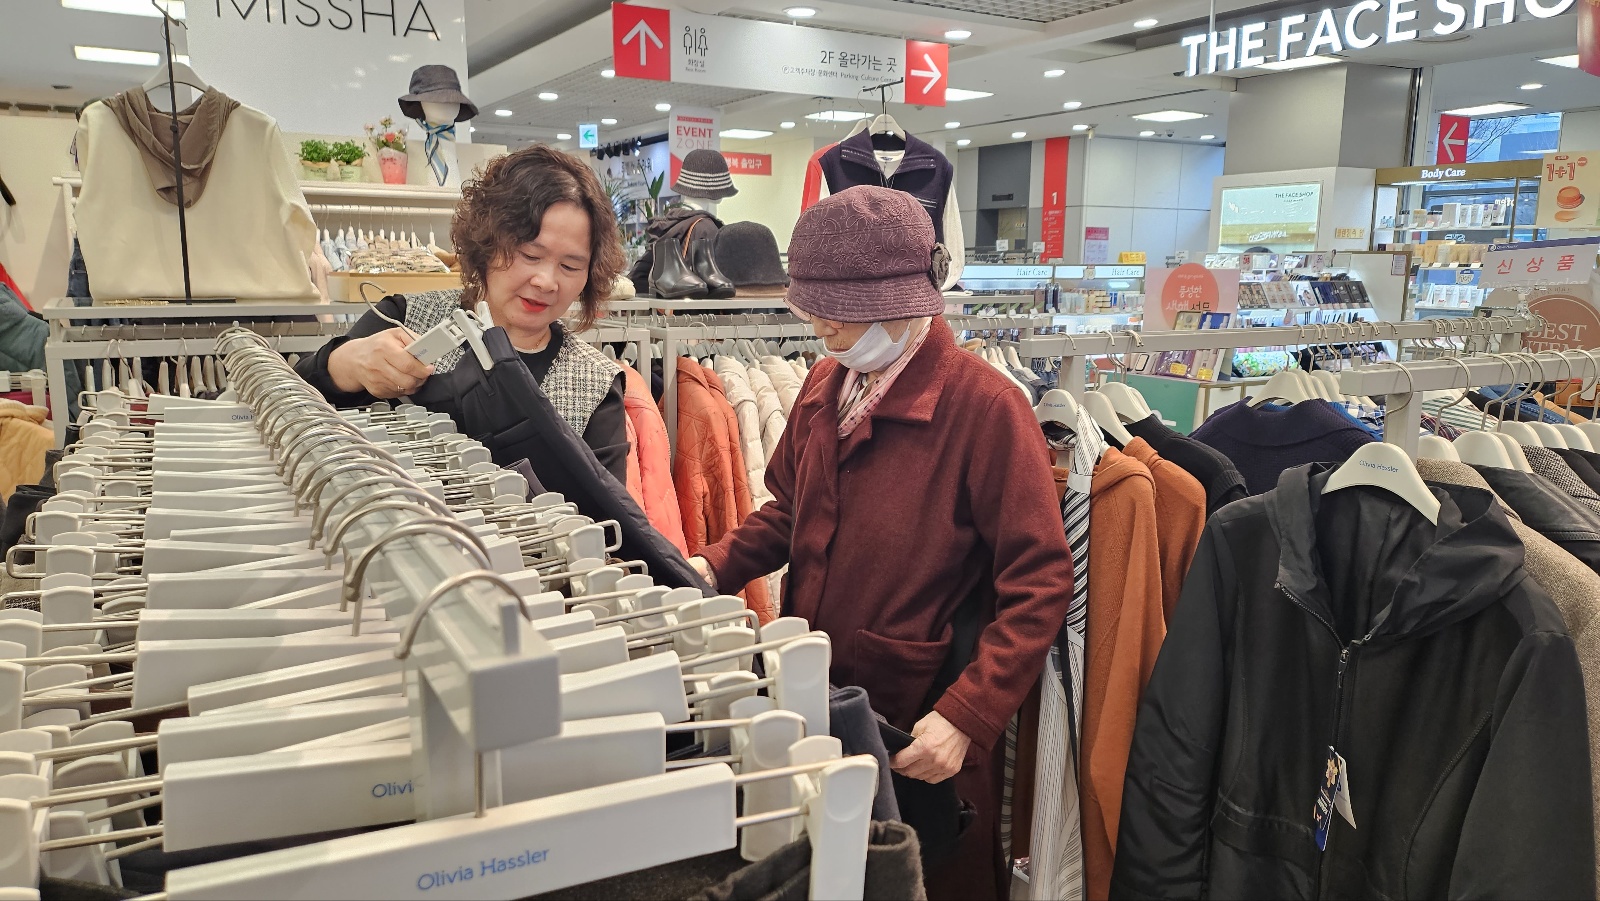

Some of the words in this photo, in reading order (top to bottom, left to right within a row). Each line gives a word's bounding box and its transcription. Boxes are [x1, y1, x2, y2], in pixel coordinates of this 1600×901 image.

[1181, 21, 1267, 77] THE
[1278, 0, 1419, 61] FACE
[820, 50, 835, 64] 2F
[838, 51, 882, 71] 올라가는
[886, 57, 897, 73] 곳
[676, 125, 714, 139] EVENT
[1421, 169, 1444, 179] Body
[1445, 167, 1467, 177] Care
[1546, 162, 1576, 182] 1+1
[1051, 191, 1058, 206] 1
[1017, 268, 1031, 276] Hair
[1111, 268, 1126, 276] Hair
[1126, 268, 1140, 276] Care
[1179, 285, 1202, 298] 풍성한
[1359, 459, 1376, 468] Olivia
[371, 779, 415, 798] Olivi
[417, 865, 475, 891] Olivia
[480, 848, 550, 877] Hassler
